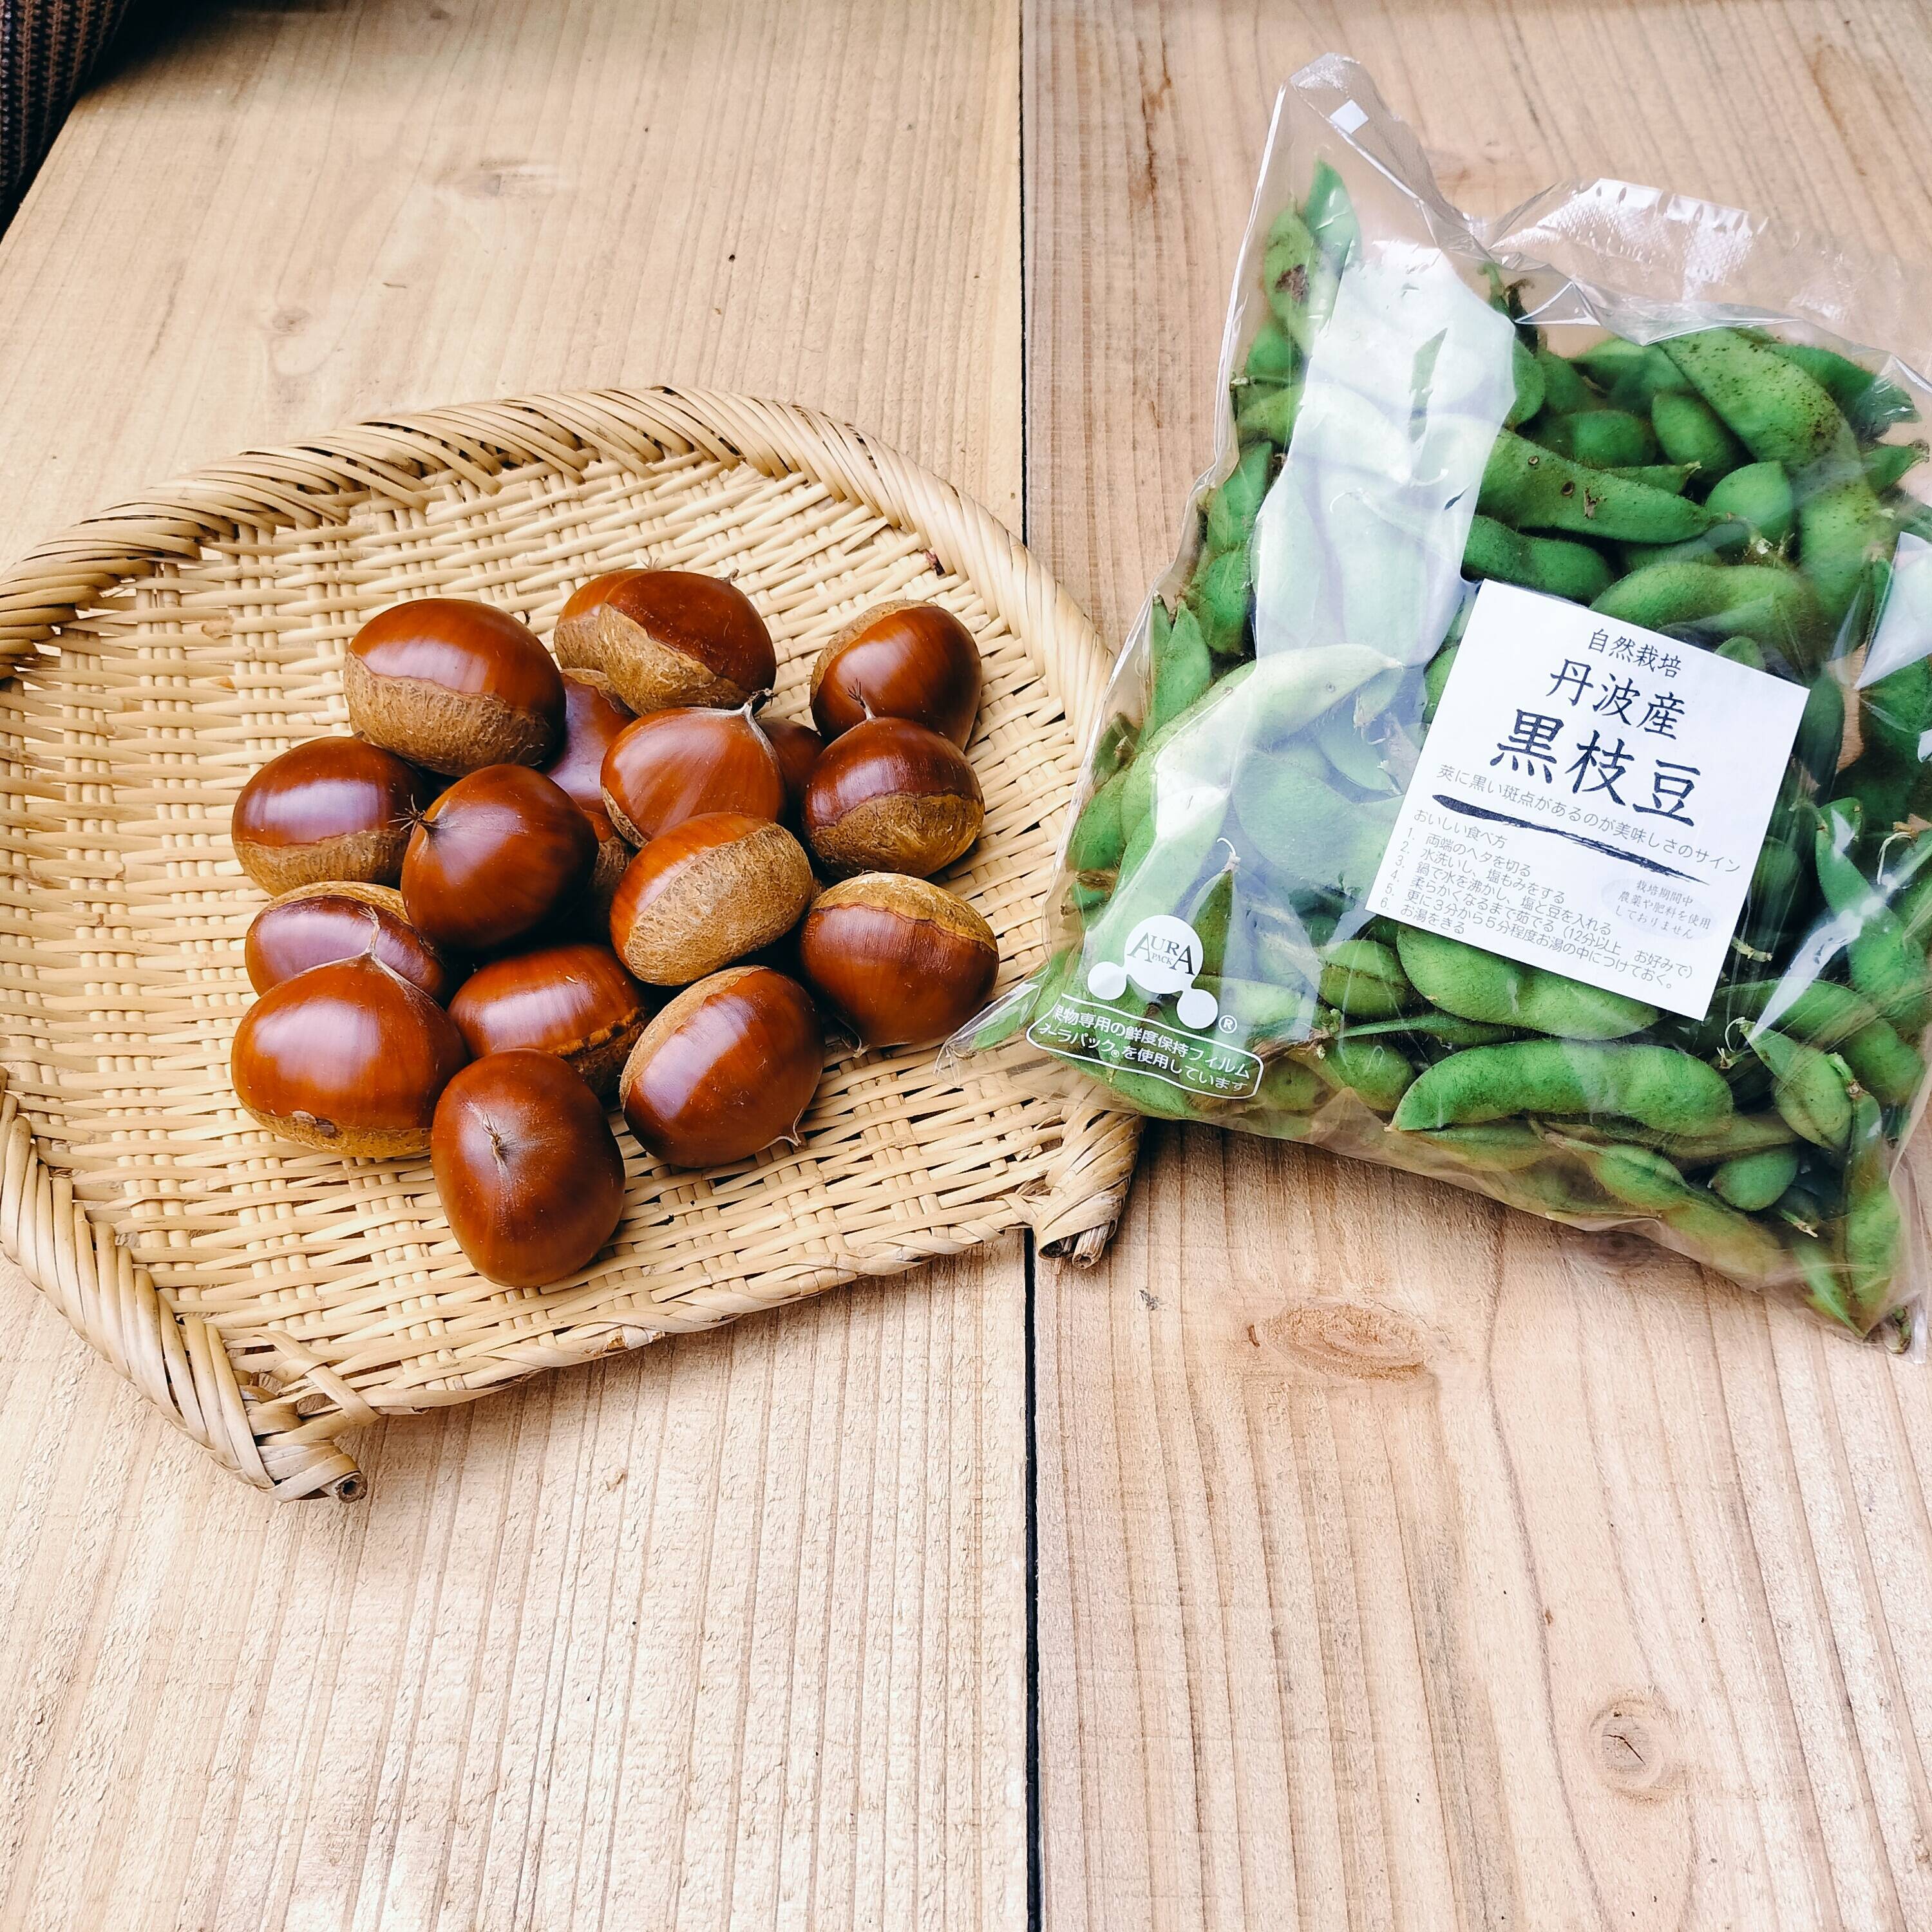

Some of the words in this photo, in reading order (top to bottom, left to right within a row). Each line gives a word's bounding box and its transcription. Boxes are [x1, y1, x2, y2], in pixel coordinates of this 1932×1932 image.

[1587, 628, 1683, 678] 自然栽培
[1545, 659, 1687, 740] 丹波産
[1489, 708, 1701, 828] 黒枝豆
[1408, 828, 1415, 840] 1.
[1414, 810, 1508, 849] おいしい食べ方
[1395, 855, 1405, 869] 3.
[1400, 841, 1410, 854] 2.
[1385, 883, 1394, 896] 5.
[1390, 869, 1399, 883] 4.
[1636, 880, 1693, 907] 栽培期間中
[1380, 896, 1389, 911] 6.
[1400, 904, 1465, 935] お湯をきる
[1615, 905, 1693, 940] しておりません
[1618, 891, 1711, 930] 農薬や肥料を使用
[1127, 932, 1196, 976] AURA
[1151, 952, 1173, 965] PACK
